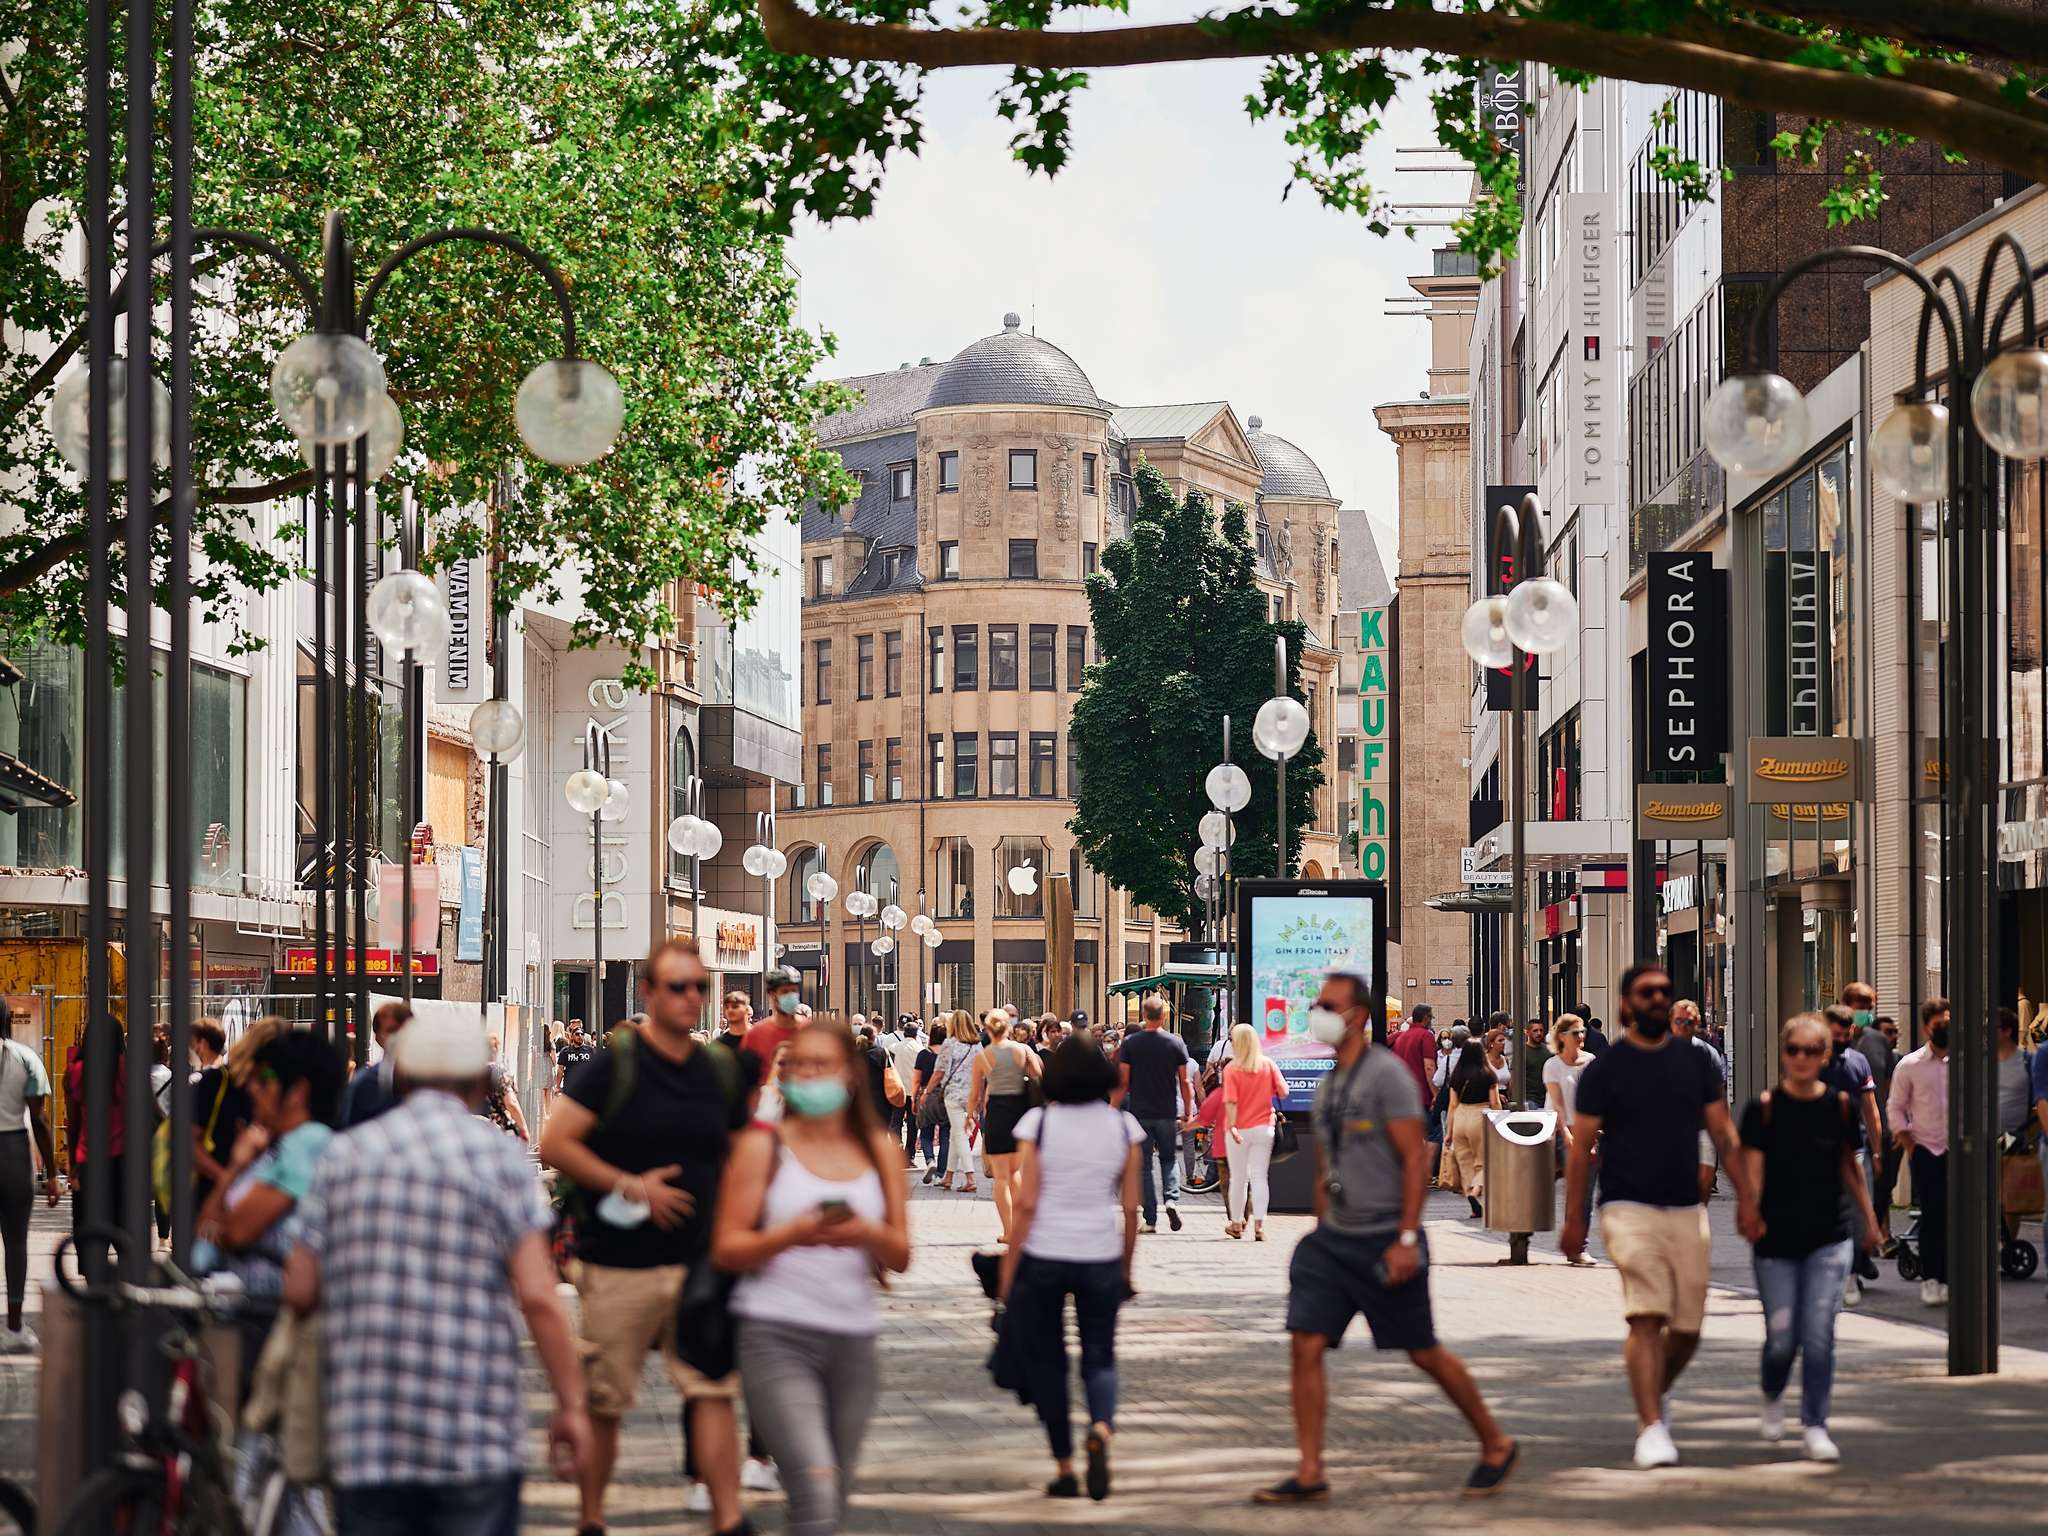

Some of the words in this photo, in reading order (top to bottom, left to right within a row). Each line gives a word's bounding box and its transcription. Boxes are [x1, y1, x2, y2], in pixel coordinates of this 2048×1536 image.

[1495, 69, 1520, 168] ABOR
[1583, 211, 1600, 327] HILFIGER
[1584, 371, 1600, 486] TOMMY
[449, 618, 469, 689] DENIM
[1667, 560, 1695, 762] SEPHORA
[1359, 610, 1387, 880] KAUFhO
[1275, 947, 1292, 955] GIN
[1295, 947, 1321, 955] FROM
[1324, 947, 1349, 955] ITALY
